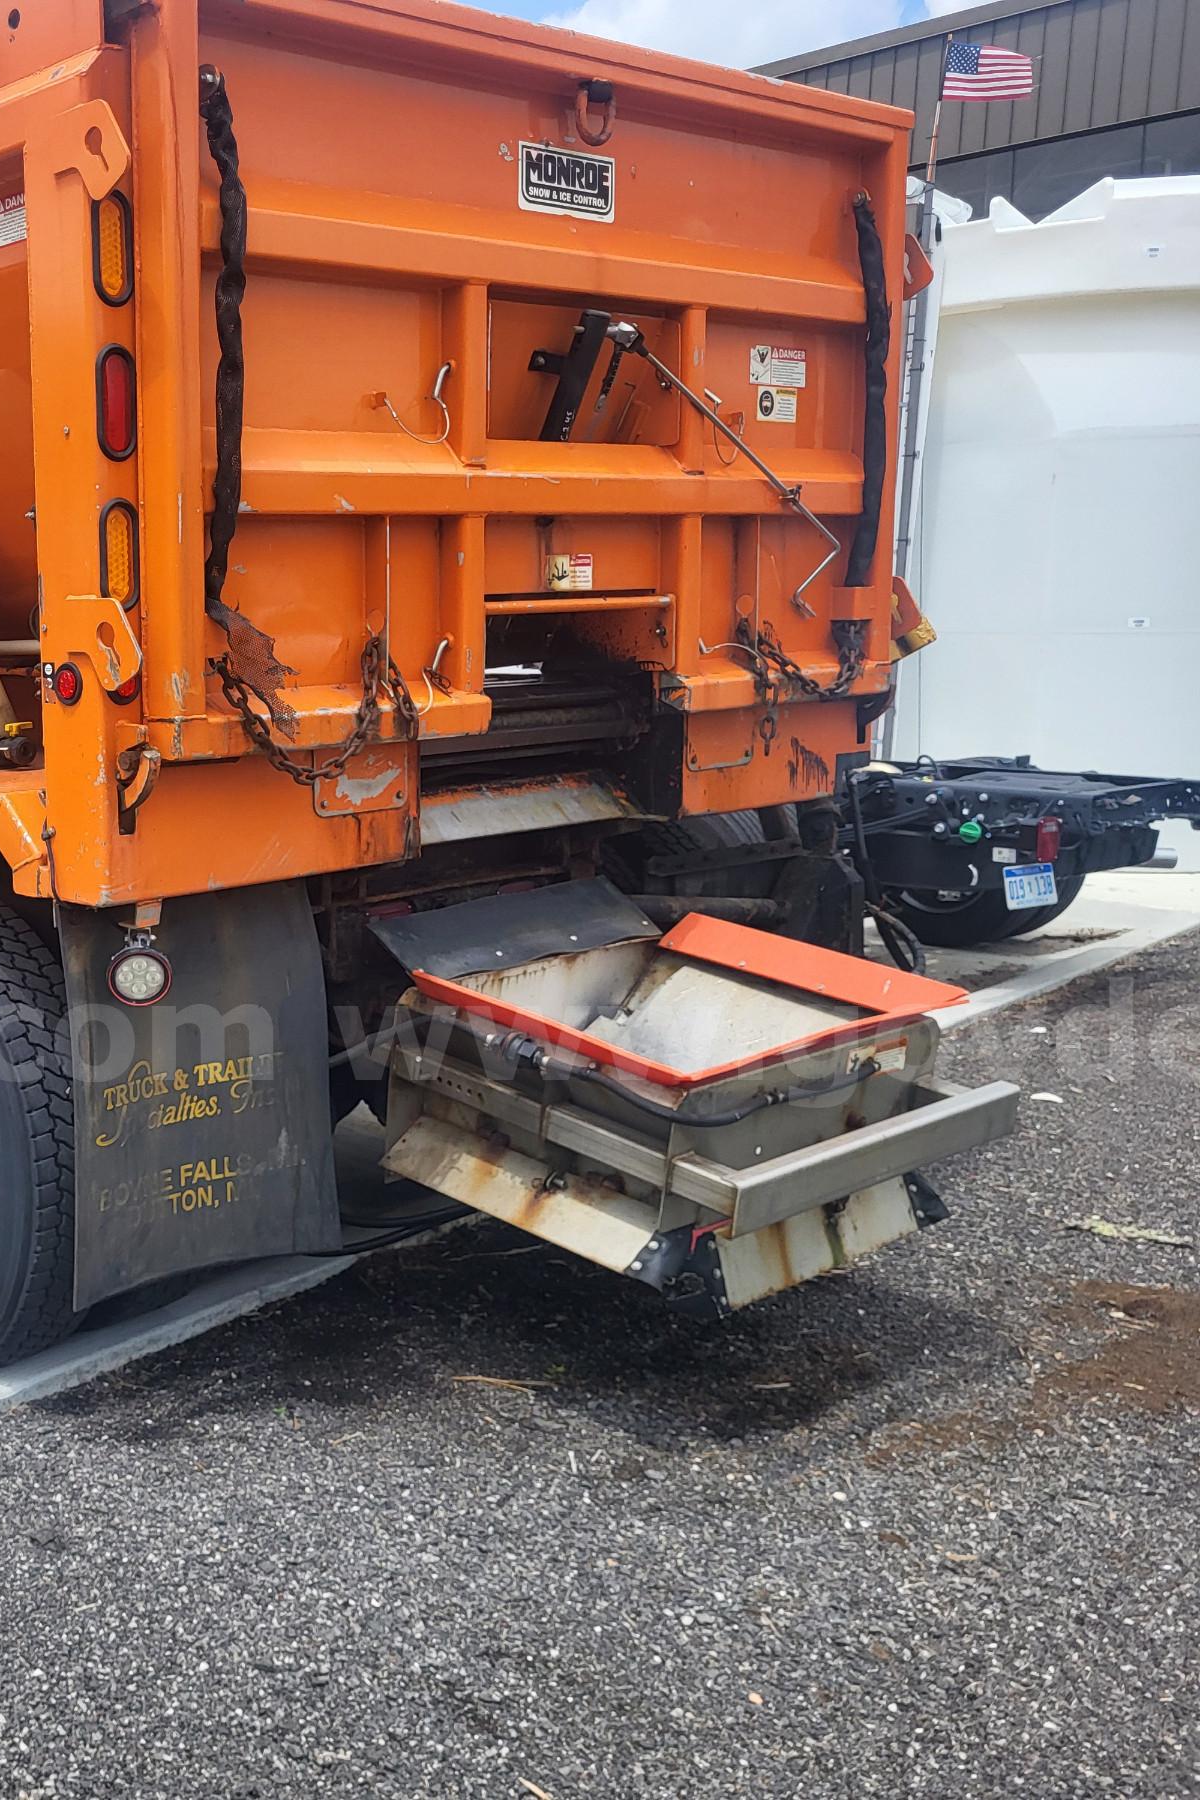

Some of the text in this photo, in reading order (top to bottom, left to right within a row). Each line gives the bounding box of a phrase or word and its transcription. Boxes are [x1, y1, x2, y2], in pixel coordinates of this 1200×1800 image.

[525, 150, 610, 194] MONROE
[5, 193, 24, 210] DAN
[528, 186, 607, 208] SNOW & ICE CONTROL
[779, 348, 805, 360] DANGER
[104, 1071, 169, 1110] TRUCK
[173, 1068, 189, 1090] &
